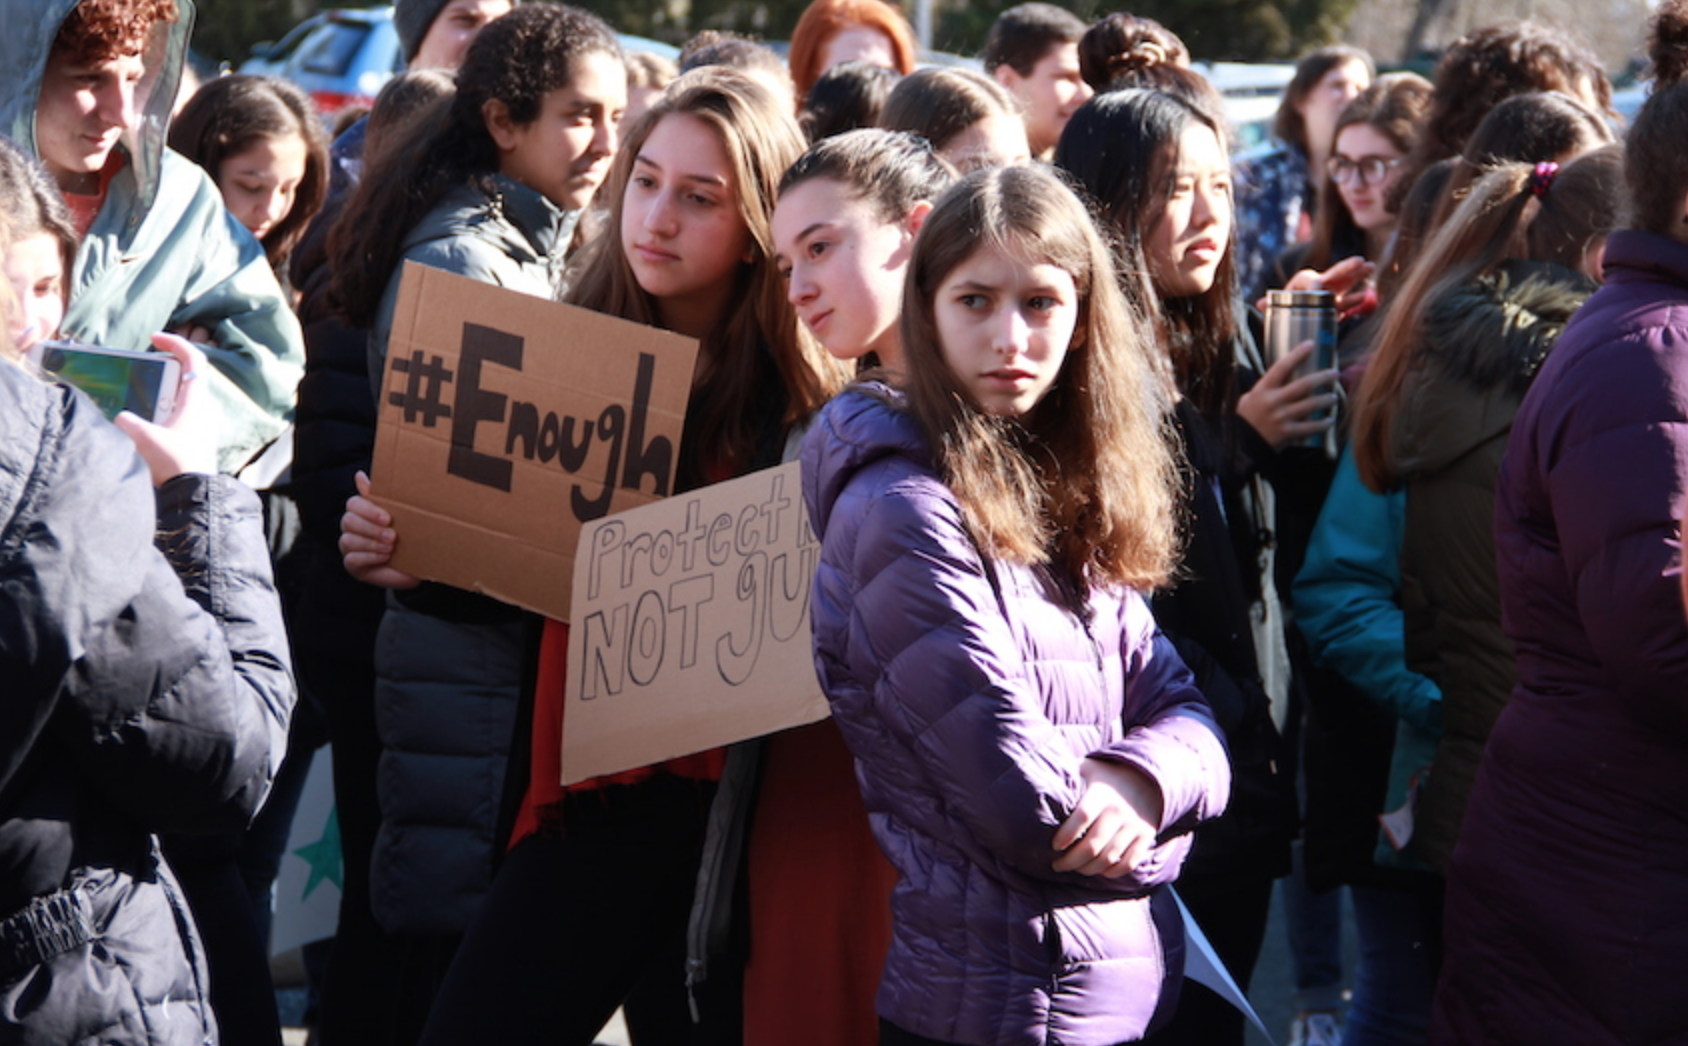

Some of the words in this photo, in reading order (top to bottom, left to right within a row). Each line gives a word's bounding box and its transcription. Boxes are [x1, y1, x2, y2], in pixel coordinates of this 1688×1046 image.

[389, 322, 673, 523] #Enough
[588, 474, 791, 600] Protect
[580, 575, 714, 700] NOT
[715, 547, 820, 686] gu
